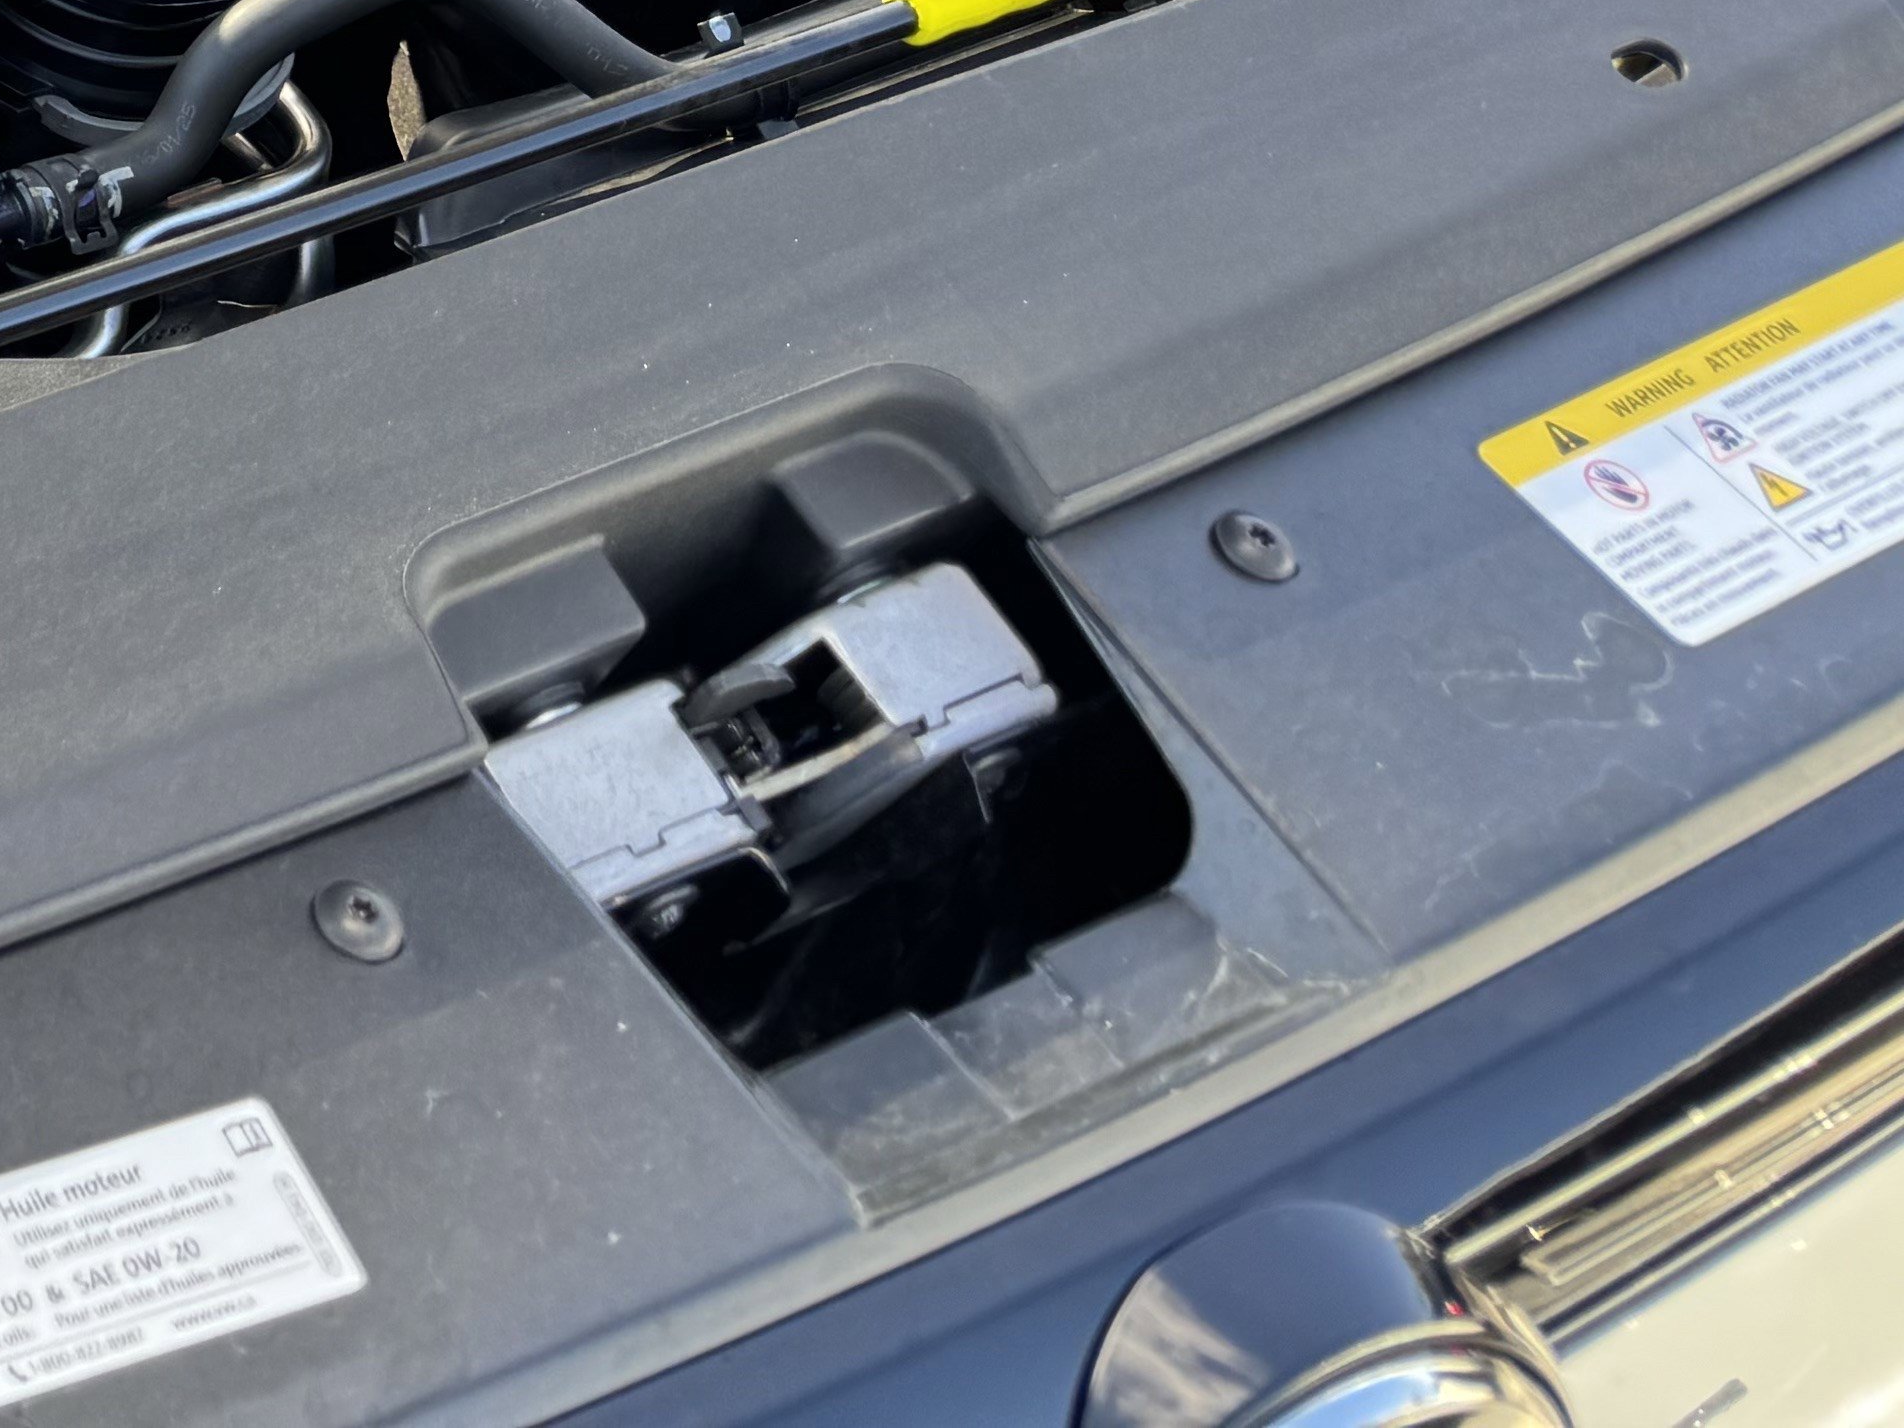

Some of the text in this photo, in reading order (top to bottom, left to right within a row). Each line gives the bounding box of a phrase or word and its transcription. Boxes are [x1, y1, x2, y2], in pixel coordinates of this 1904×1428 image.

[1605, 318, 1800, 418] WARNING ATTENTION
[64, 1165, 142, 1202] moteur
[13, 1219, 71, 1248] Utilisez
[74, 1191, 167, 1233] uniquement
[168, 1182, 187, 1199] de
[24, 1247, 51, 1270] qui
[56, 1228, 112, 1259] satisfait
[116, 1195, 221, 1240] expressément
[0, 1289, 34, 1316] 00
[45, 1283, 64, 1303] &
[72, 1263, 119, 1295] SAE
[54, 1305, 91, 1329] Pour
[94, 1298, 121, 1318] une
[124, 1284, 156, 1308] liste
